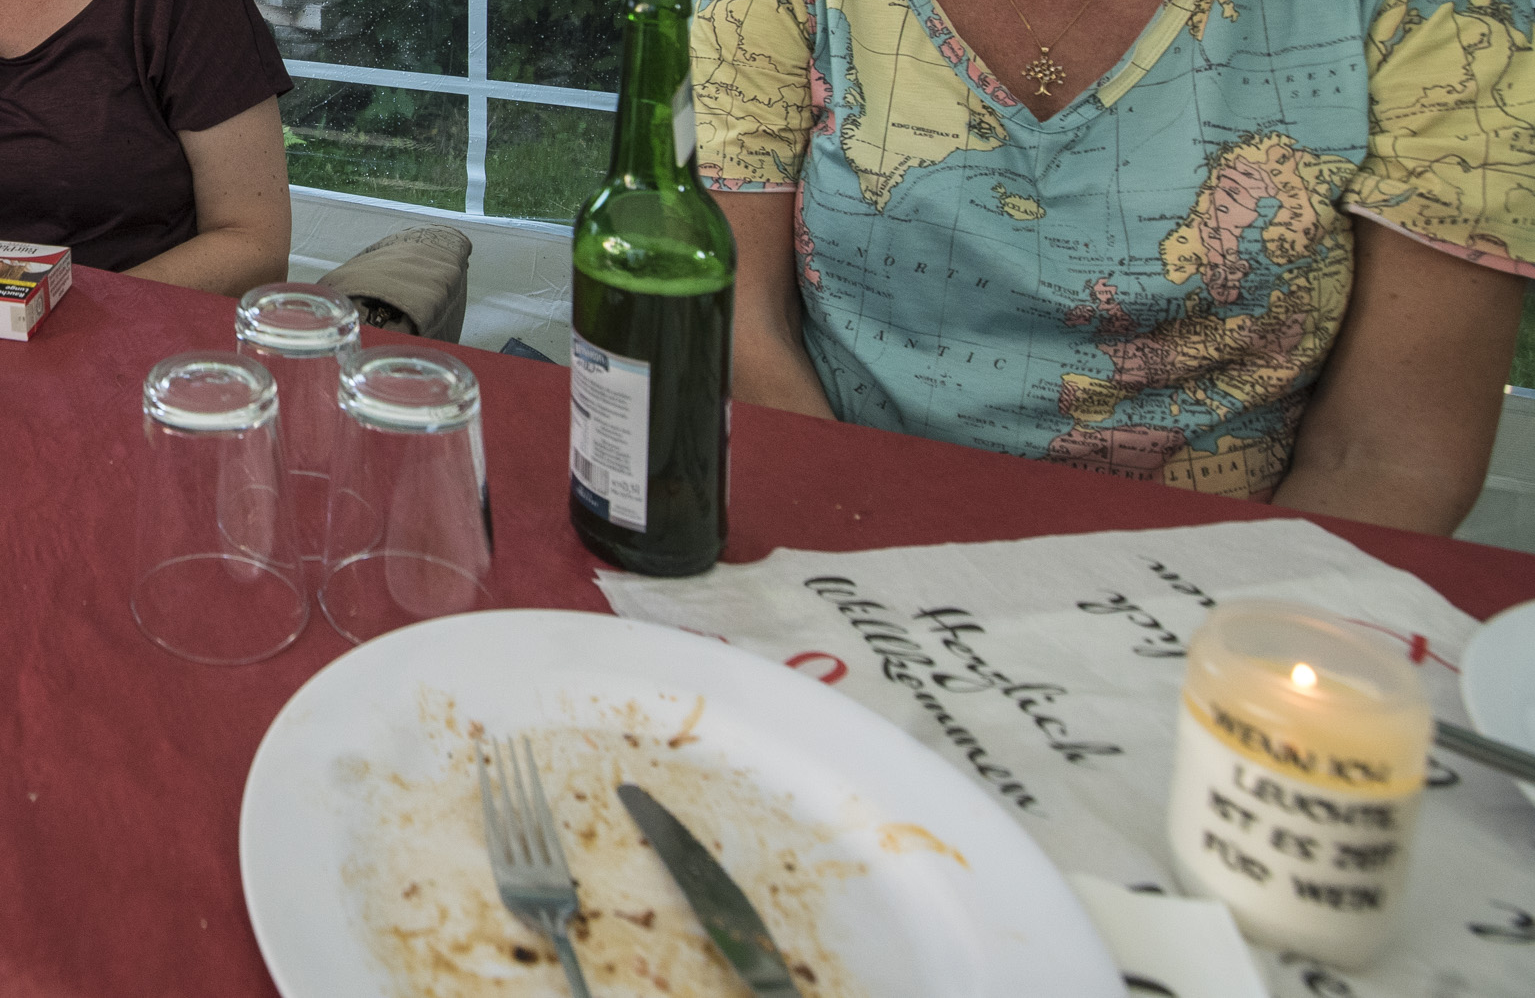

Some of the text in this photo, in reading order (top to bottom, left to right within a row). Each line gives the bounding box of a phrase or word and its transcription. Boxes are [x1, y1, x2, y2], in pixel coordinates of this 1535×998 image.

[891, 121, 910, 131] KING
[913, 131, 934, 139] LAND
[5, 285, 30, 293] Lunge
[912, 606, 1124, 769] Herzlich
[803, 575, 1049, 819] Willkommen
